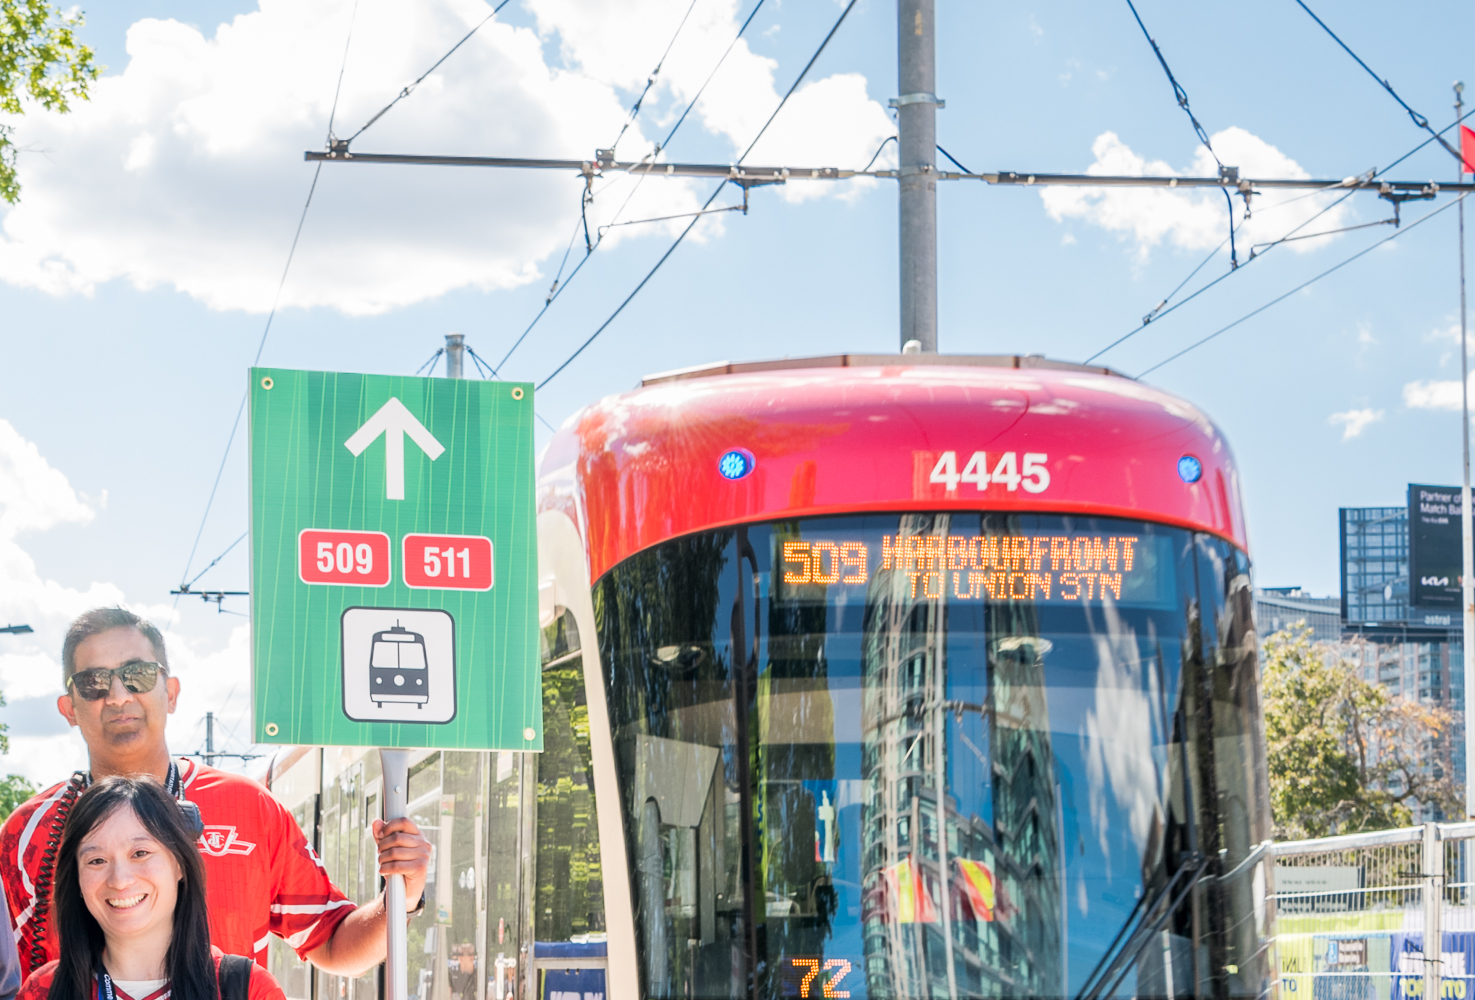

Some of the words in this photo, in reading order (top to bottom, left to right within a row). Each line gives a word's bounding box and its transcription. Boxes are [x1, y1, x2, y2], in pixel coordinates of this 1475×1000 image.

[929, 451, 1051, 493] 4445
[1420, 490, 1451, 503] Partner
[1420, 503, 1447, 515] Match
[316, 541, 373, 574] 509
[423, 546, 470, 578] 511
[783, 541, 868, 585] 509
[882, 535, 1138, 572] HARBOURFRONT
[908, 571, 943, 600] TO
[954, 572, 1051, 600] UNION
[1060, 572, 1122, 600] STN
[1424, 615, 1451, 625] astral
[791, 958, 852, 1000] 72
